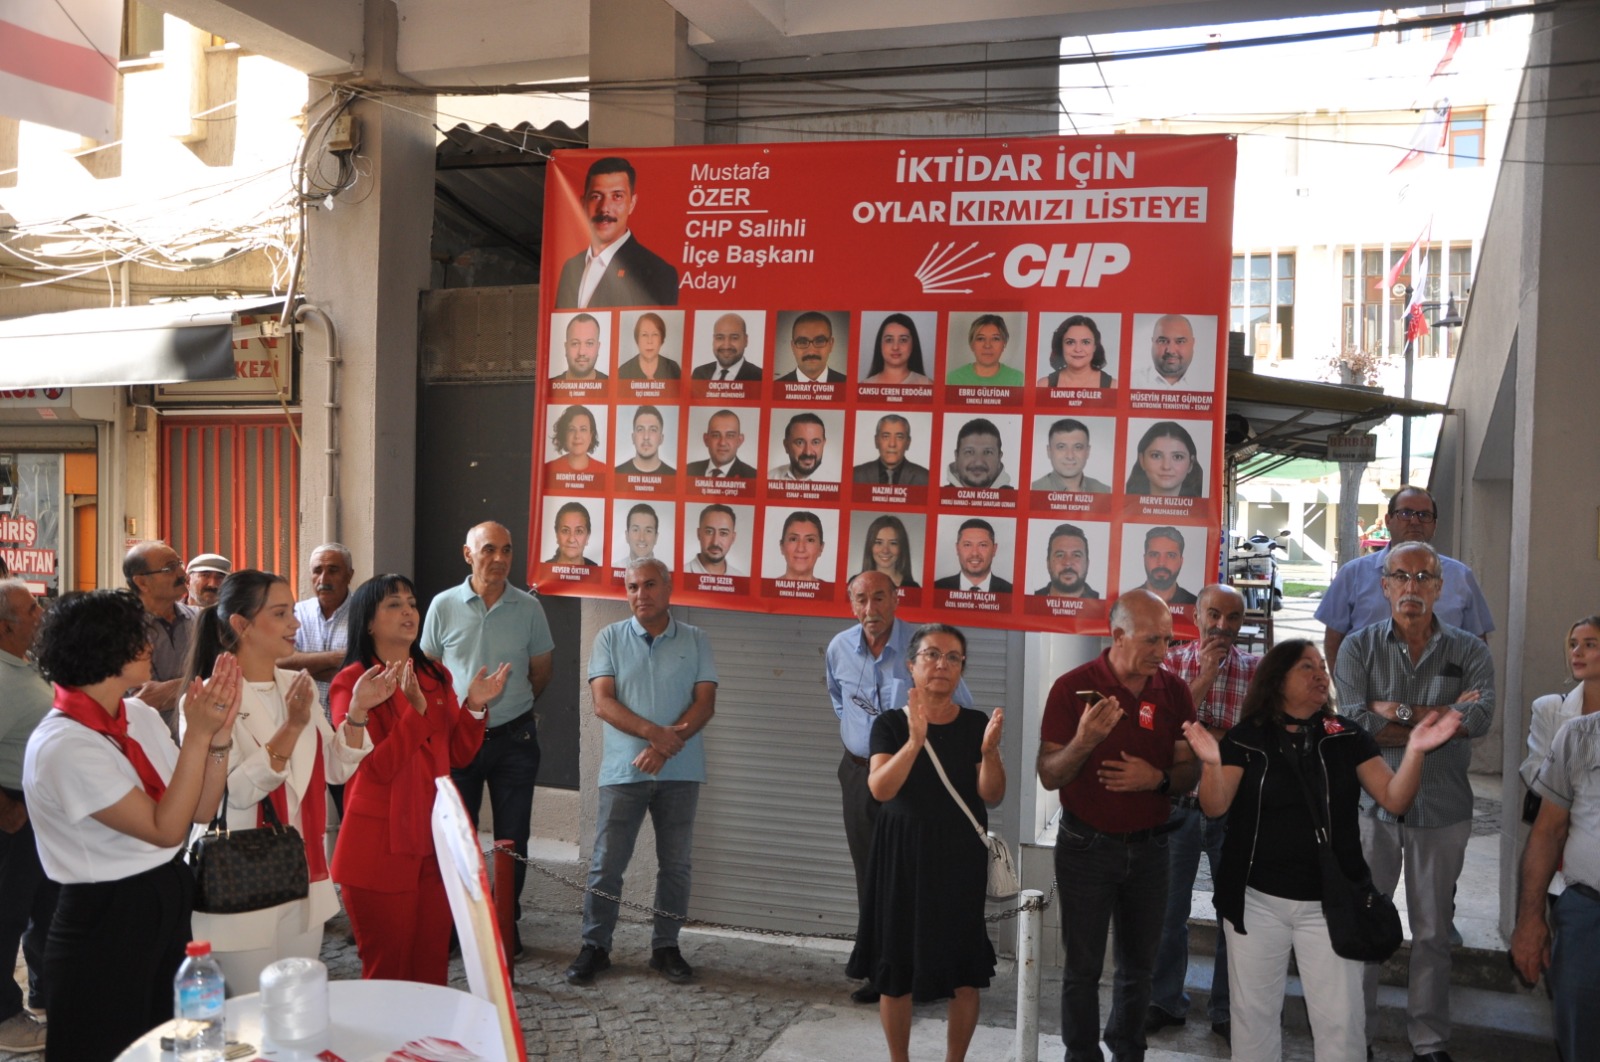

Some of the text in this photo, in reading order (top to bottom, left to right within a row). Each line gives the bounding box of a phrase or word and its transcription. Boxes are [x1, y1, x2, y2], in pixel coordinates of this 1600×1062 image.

[690, 162, 770, 181] Mustafa
[896, 144, 1135, 188] İKTİDAR İÇİN
[688, 185, 750, 207] ÖZER
[852, 191, 1200, 223] OYLAR KIRMIZI LİSTEYE
[685, 219, 806, 238] CHP Salihli
[682, 242, 814, 267] İlçe Başkanı
[1003, 242, 1131, 288] CHP
[678, 272, 737, 293] Adayı
[235, 354, 279, 378] KEZİ
[552, 380, 602, 390] DOĞUKAN ALPASLAN
[650, 381, 666, 390] BİLEK
[708, 382, 730, 391] ORÇUN
[785, 384, 834, 394] YILDIRAY ÇIVGIN
[858, 387, 879, 395] CANSU
[902, 387, 932, 396] ERDOĞAN
[959, 388, 1010, 398] EBRU GÜLFİDAN
[1050, 388, 1102, 399] İLKNUR GÜLLER
[1130, 392, 1212, 404] HÜSEYİN FIRAT GÜNDEM
[556, 472, 594, 482] BEDRİYE GÜNEY
[628, 475, 662, 484] EREN KALKAN
[695, 478, 746, 489] İSMAİL KARABIYIK
[768, 480, 838, 492] HALİL İBRAHİM KARAHAN
[872, 486, 907, 498] NAZMİ KOÇ
[958, 490, 999, 500] OZAN KÖSEM
[1048, 492, 1094, 503] CÜNEYT KUZU
[1140, 496, 1193, 506] MERVE KUZUCU
[1152, 508, 1189, 516] MUHASEBECİ
[552, 566, 590, 576] KEVSER ÖKTEM
[614, 570, 626, 578] MUS
[700, 575, 733, 586] ÇETİN SEZER
[775, 580, 820, 591] NALAN ŞAHPAZ
[950, 591, 996, 602] EMRAH YALÇIN
[978, 602, 1000, 611] YÖNETİCİ
[1046, 598, 1083, 609] VELİ YAVUZ
[1169, 606, 1184, 614] MAZ
